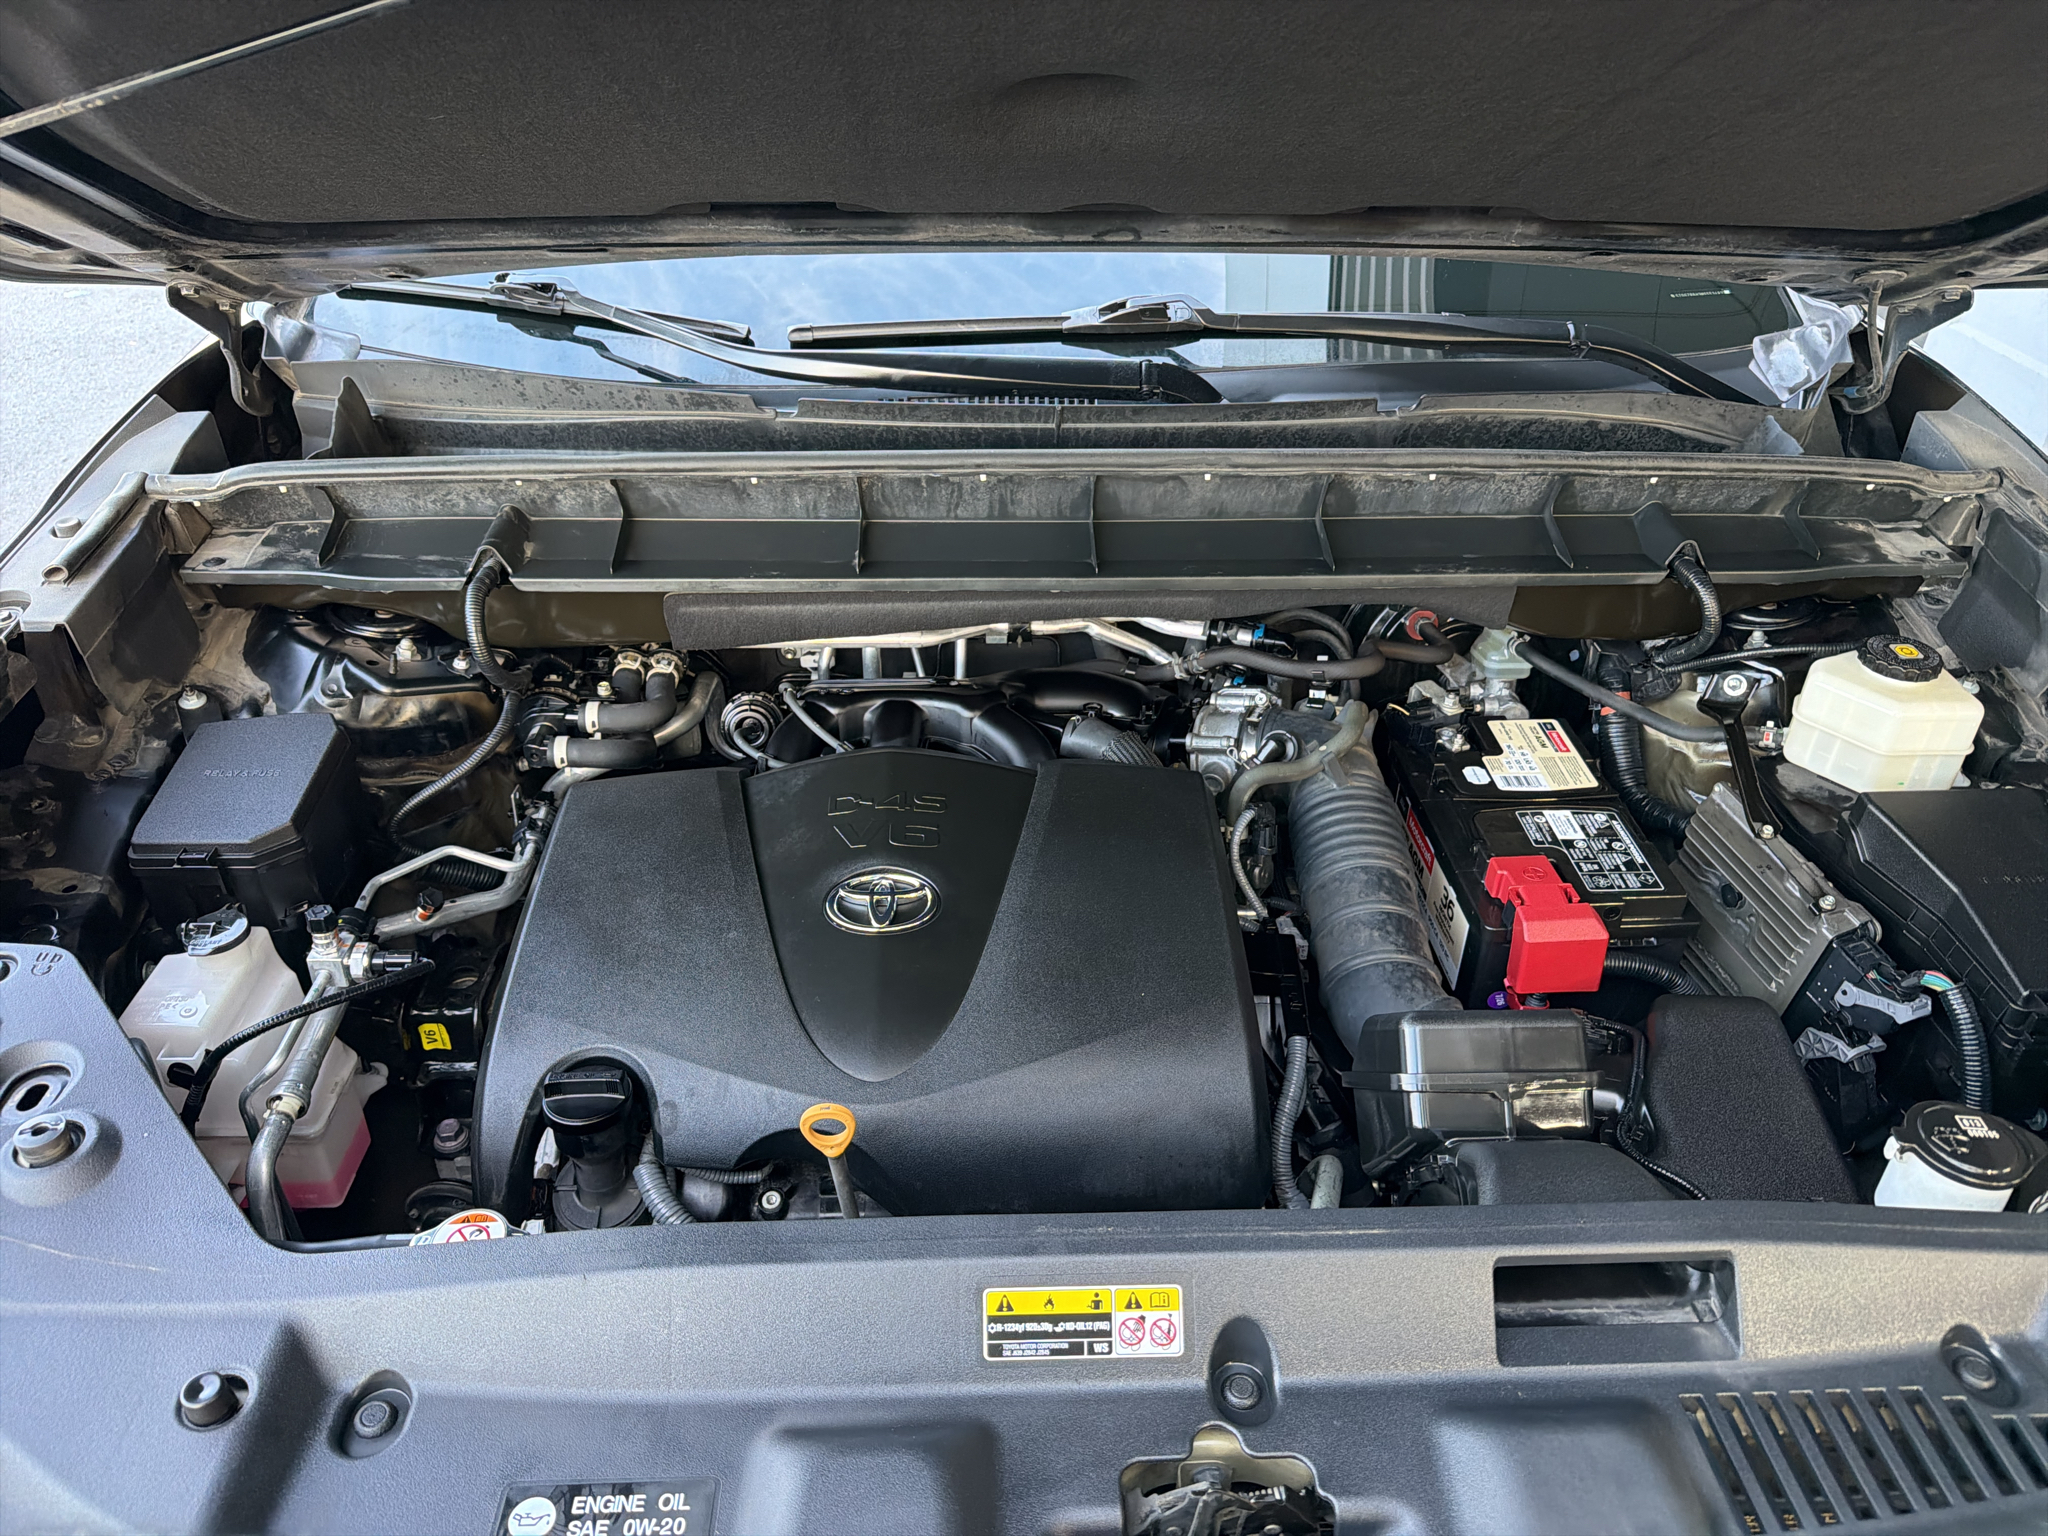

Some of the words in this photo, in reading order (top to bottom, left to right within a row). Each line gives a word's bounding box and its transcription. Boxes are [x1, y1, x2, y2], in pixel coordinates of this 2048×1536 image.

[203, 769, 239, 778] RELAY
[827, 792, 947, 816] D-4S
[833, 820, 941, 849] V6
[1408, 815, 1432, 868] Motorcraft
[1408, 842, 1424, 880] AGM
[1441, 885, 1456, 922] 36
[424, 1029, 438, 1045] V6
[1093, 1343, 1109, 1353] WS
[571, 1494, 647, 1514] ENGINE
[658, 1493, 690, 1511] OIL
[566, 1520, 610, 1536] SAE
[622, 1517, 686, 1536] 0W-20
